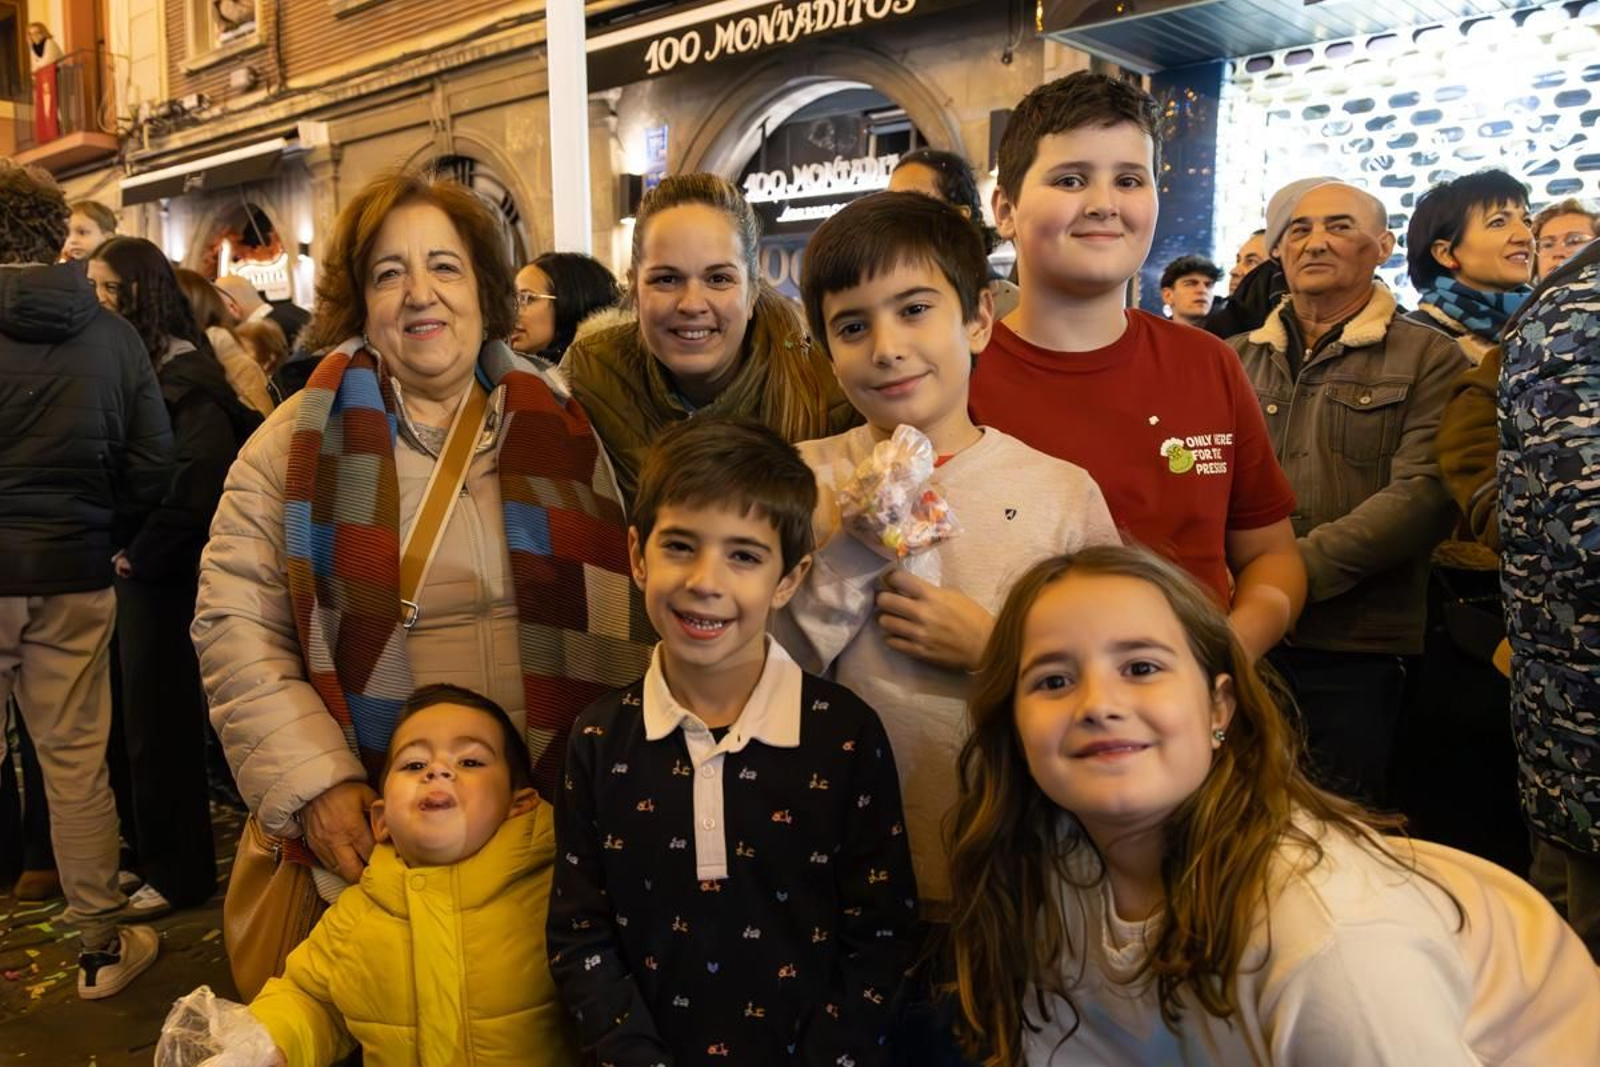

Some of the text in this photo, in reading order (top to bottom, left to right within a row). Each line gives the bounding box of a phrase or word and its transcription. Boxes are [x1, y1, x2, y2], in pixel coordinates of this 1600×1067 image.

[645, 31, 700, 74] 100
[743, 153, 899, 203] 100 MONTADIT
[1185, 434, 1212, 447] ONLY
[1192, 448, 1213, 460] FOR
